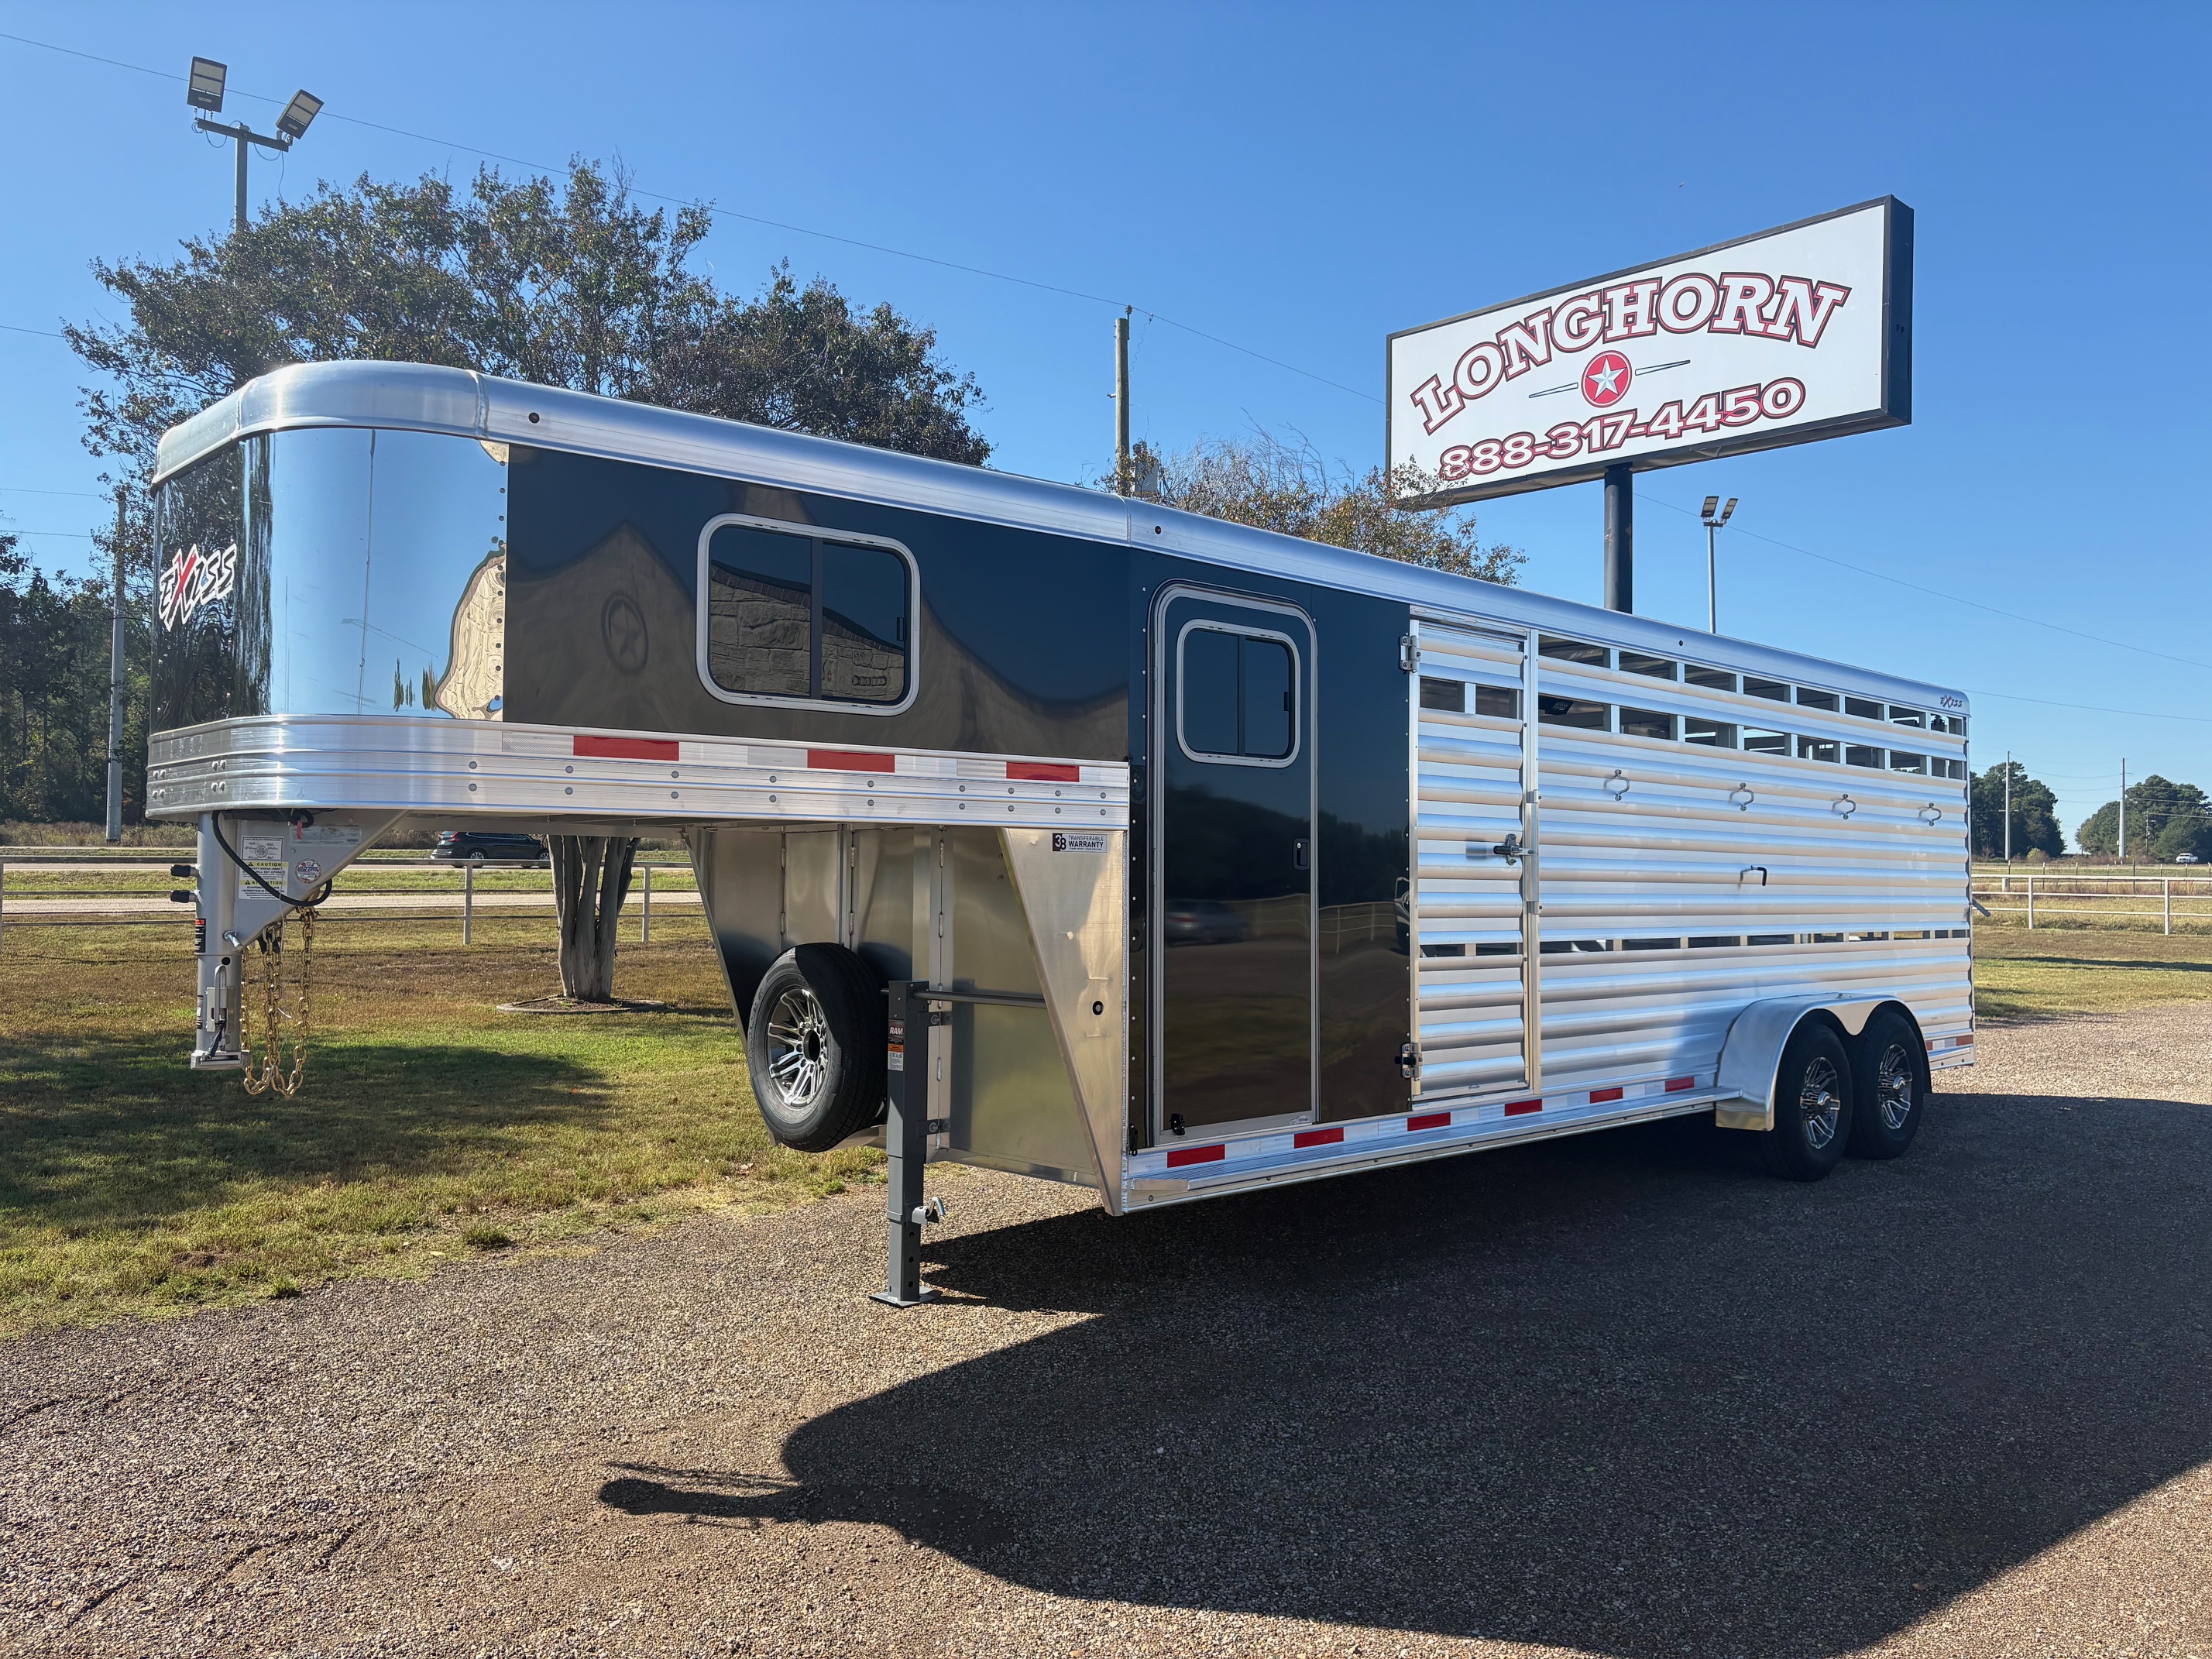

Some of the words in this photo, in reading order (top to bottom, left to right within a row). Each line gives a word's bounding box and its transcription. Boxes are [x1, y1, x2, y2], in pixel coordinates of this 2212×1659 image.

[1411, 272, 1852, 435] LONGHORN
[1439, 377, 1805, 481] 888-317-4450
[889, 1026, 904, 1035] RAM
